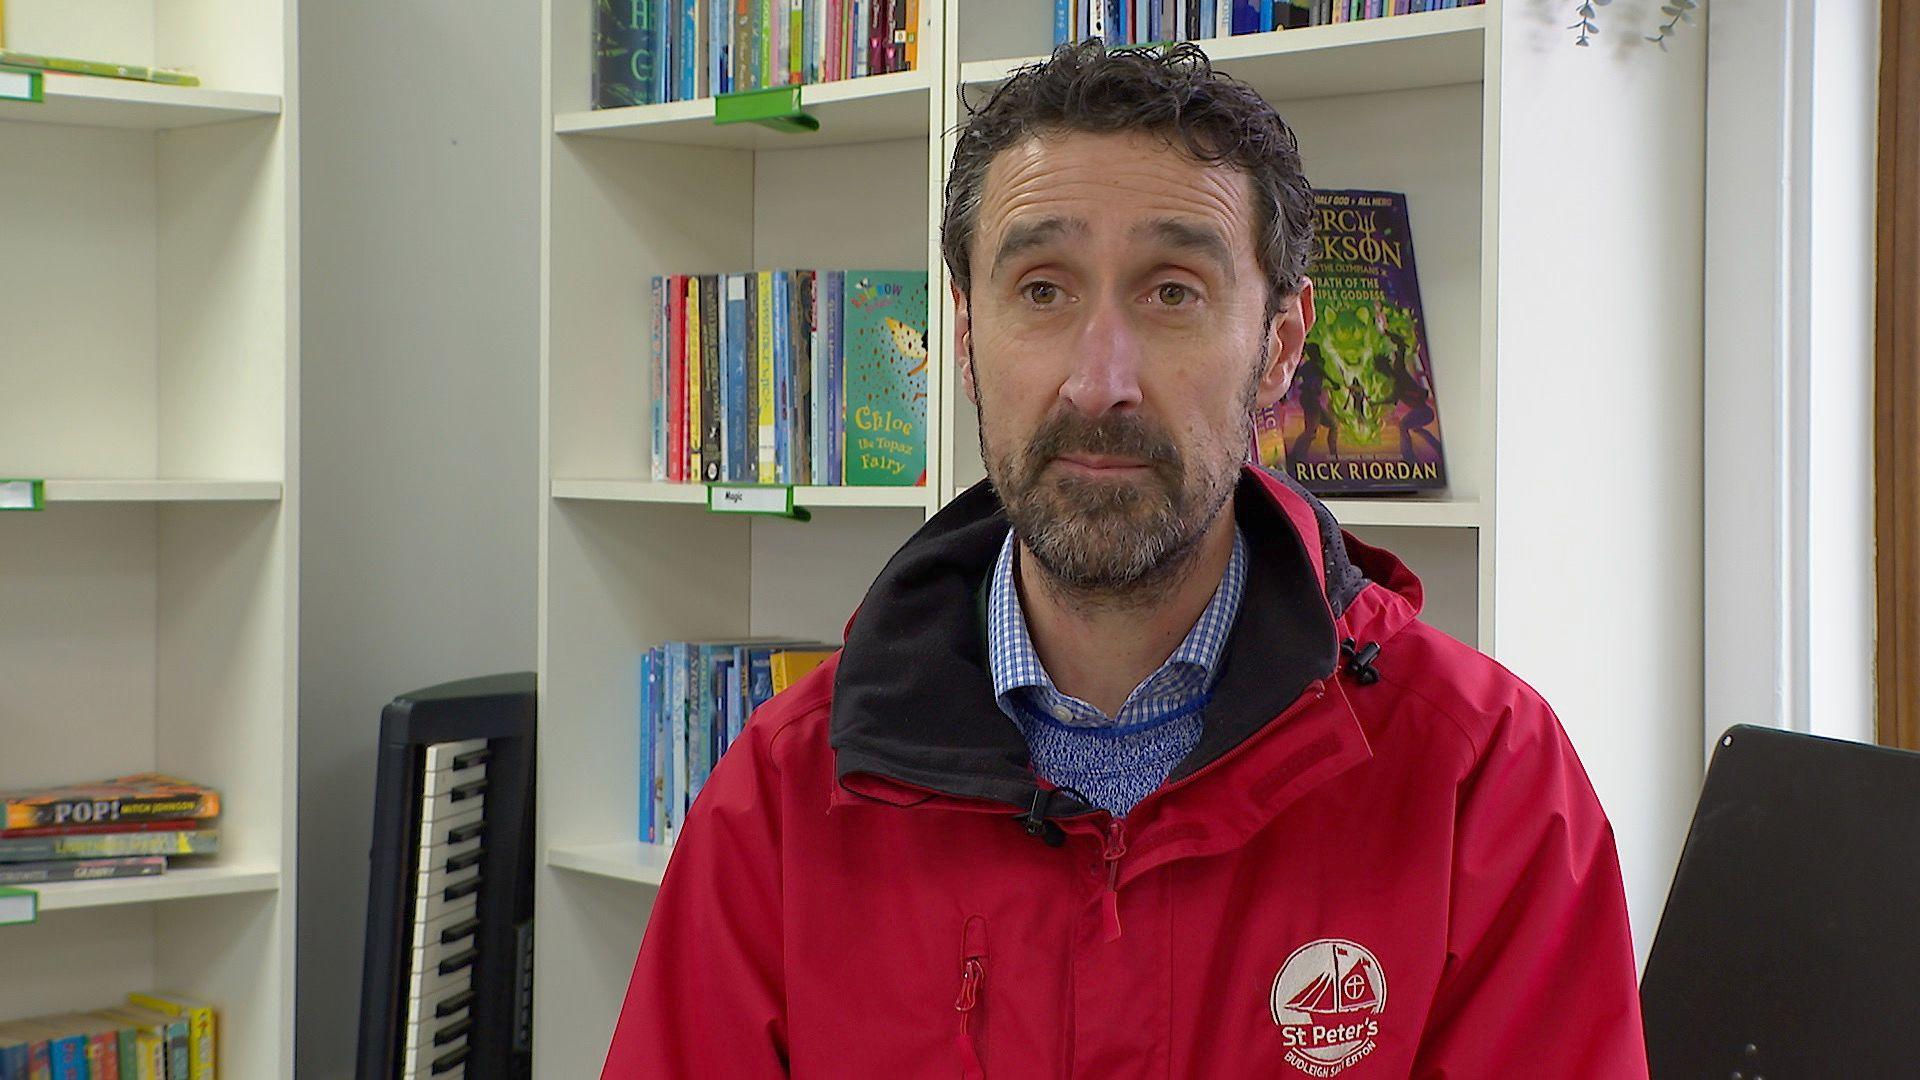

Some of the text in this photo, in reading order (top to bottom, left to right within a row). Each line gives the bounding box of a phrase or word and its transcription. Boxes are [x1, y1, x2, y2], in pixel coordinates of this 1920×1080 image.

[1311, 208, 1376, 233] ERCY
[1344, 276, 1359, 289] OF
[1360, 278, 1379, 290] THE
[1340, 289, 1387, 302] GODDESS
[854, 404, 913, 436] Chloe
[858, 436, 913, 455] the Topaz
[860, 453, 906, 475] Fairy
[1296, 462, 1438, 481] RICK RIORDAN
[725, 490, 743, 503] Magic
[53, 800, 121, 825] POP!
[1282, 1017, 1379, 1046] St Peter's
[1284, 1050, 1330, 1078] BUDLEIGH
